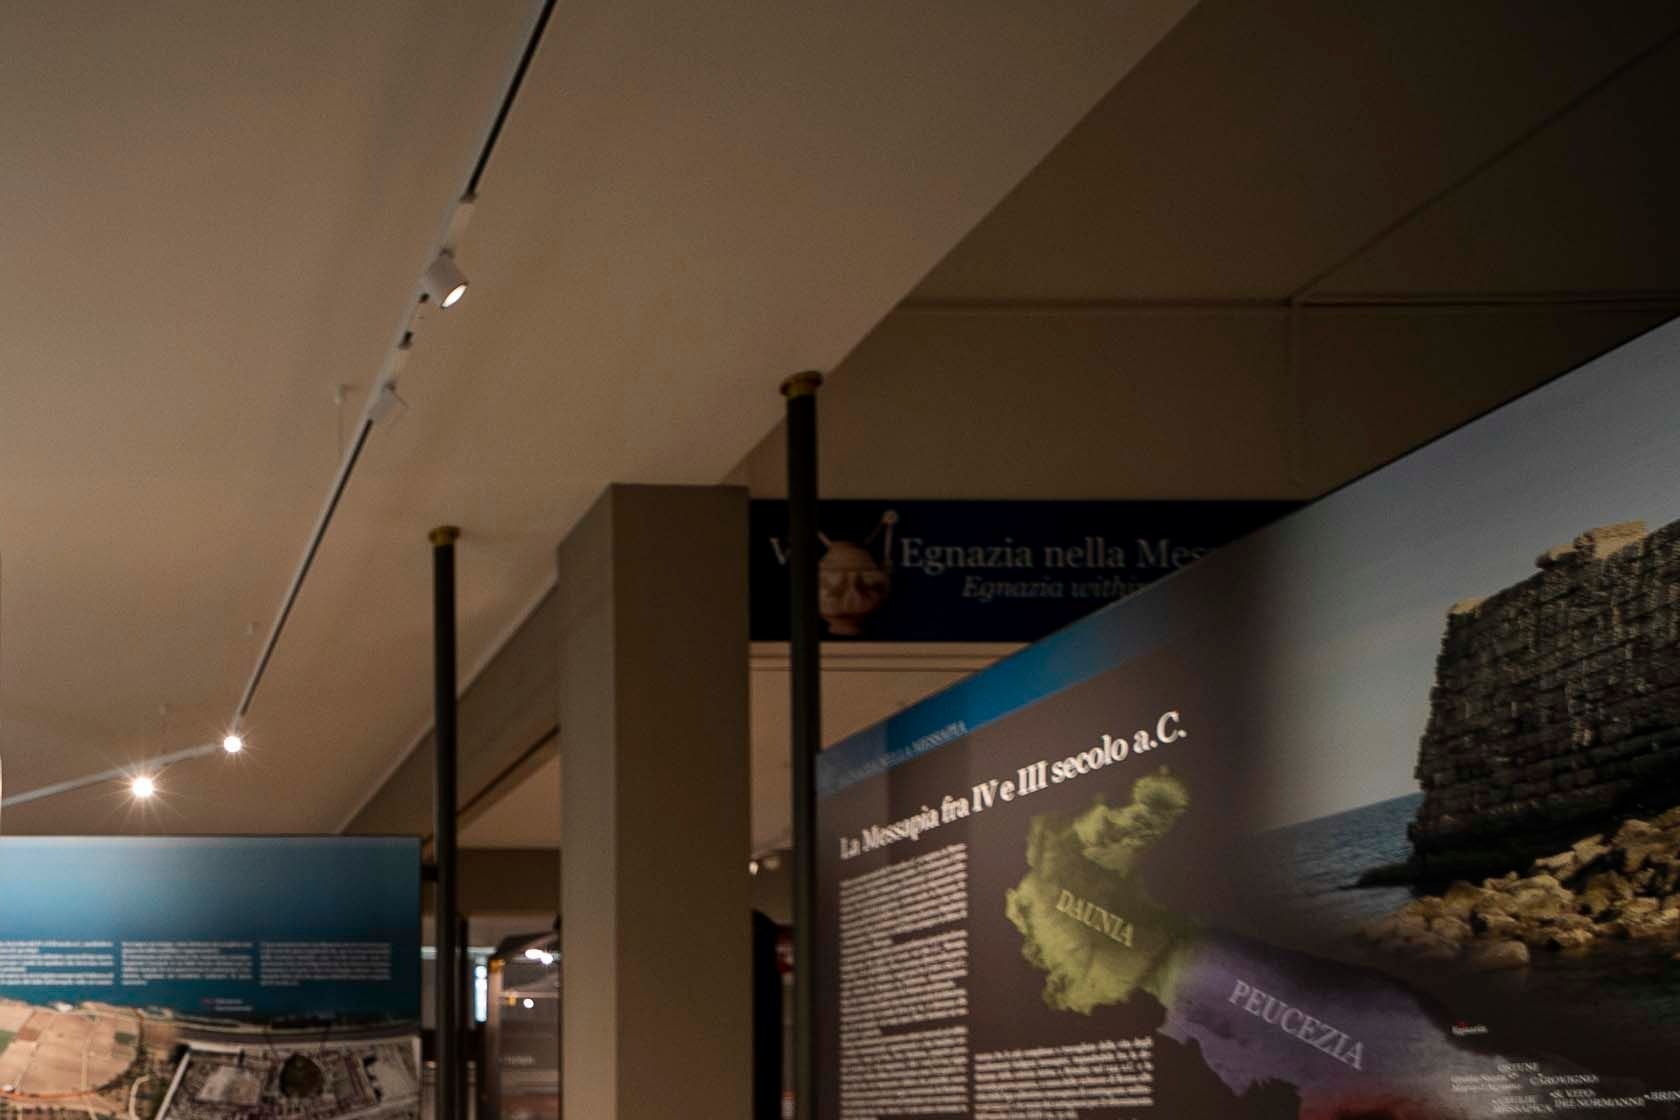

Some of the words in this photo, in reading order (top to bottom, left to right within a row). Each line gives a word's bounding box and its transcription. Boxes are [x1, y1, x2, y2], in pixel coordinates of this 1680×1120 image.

[899, 537, 1032, 575] Egnazia
[1043, 536, 1126, 569] nella
[961, 575, 1065, 603] Egnazia
[839, 836, 861, 860] La
[861, 803, 940, 853] Messapia
[940, 795, 970, 824] fra
[971, 779, 1000, 813] IV
[999, 777, 1016, 801] e
[1017, 760, 1049, 796] III
[1050, 735, 1128, 785] secolo
[1056, 889, 1134, 948] DAUNIA
[1228, 979, 1365, 1070] PEUCEZIA
